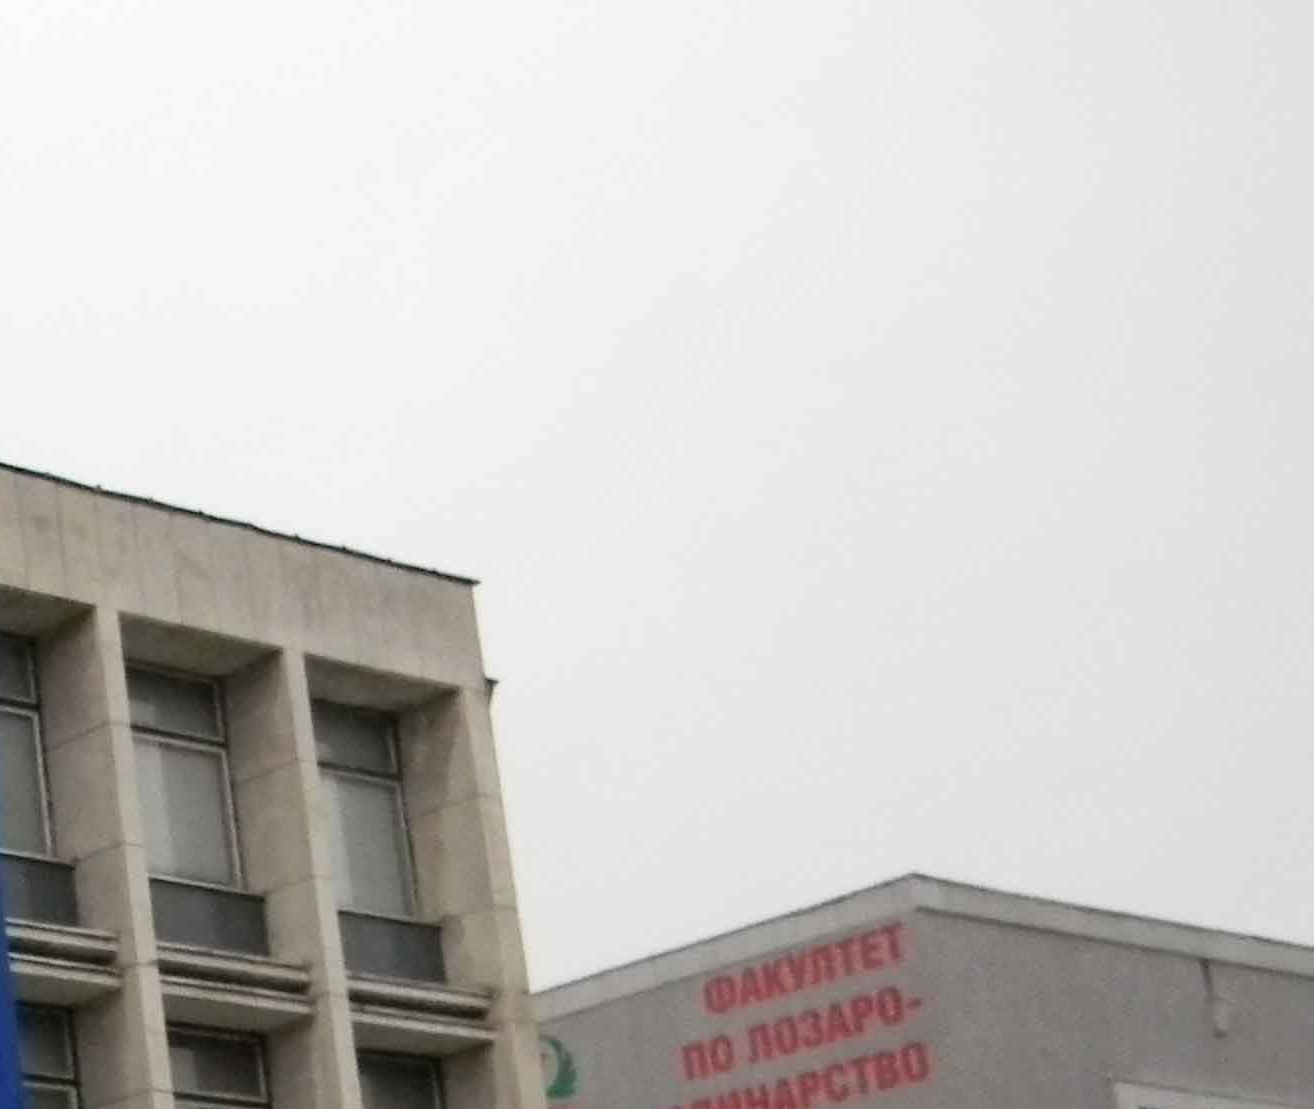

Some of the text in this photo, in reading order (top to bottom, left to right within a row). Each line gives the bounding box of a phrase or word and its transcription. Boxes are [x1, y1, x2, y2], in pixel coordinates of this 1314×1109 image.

[703, 922, 905, 1014] ФАКУЛТЕТ
[681, 986, 923, 1081] ПО ЛОЗАРО-
